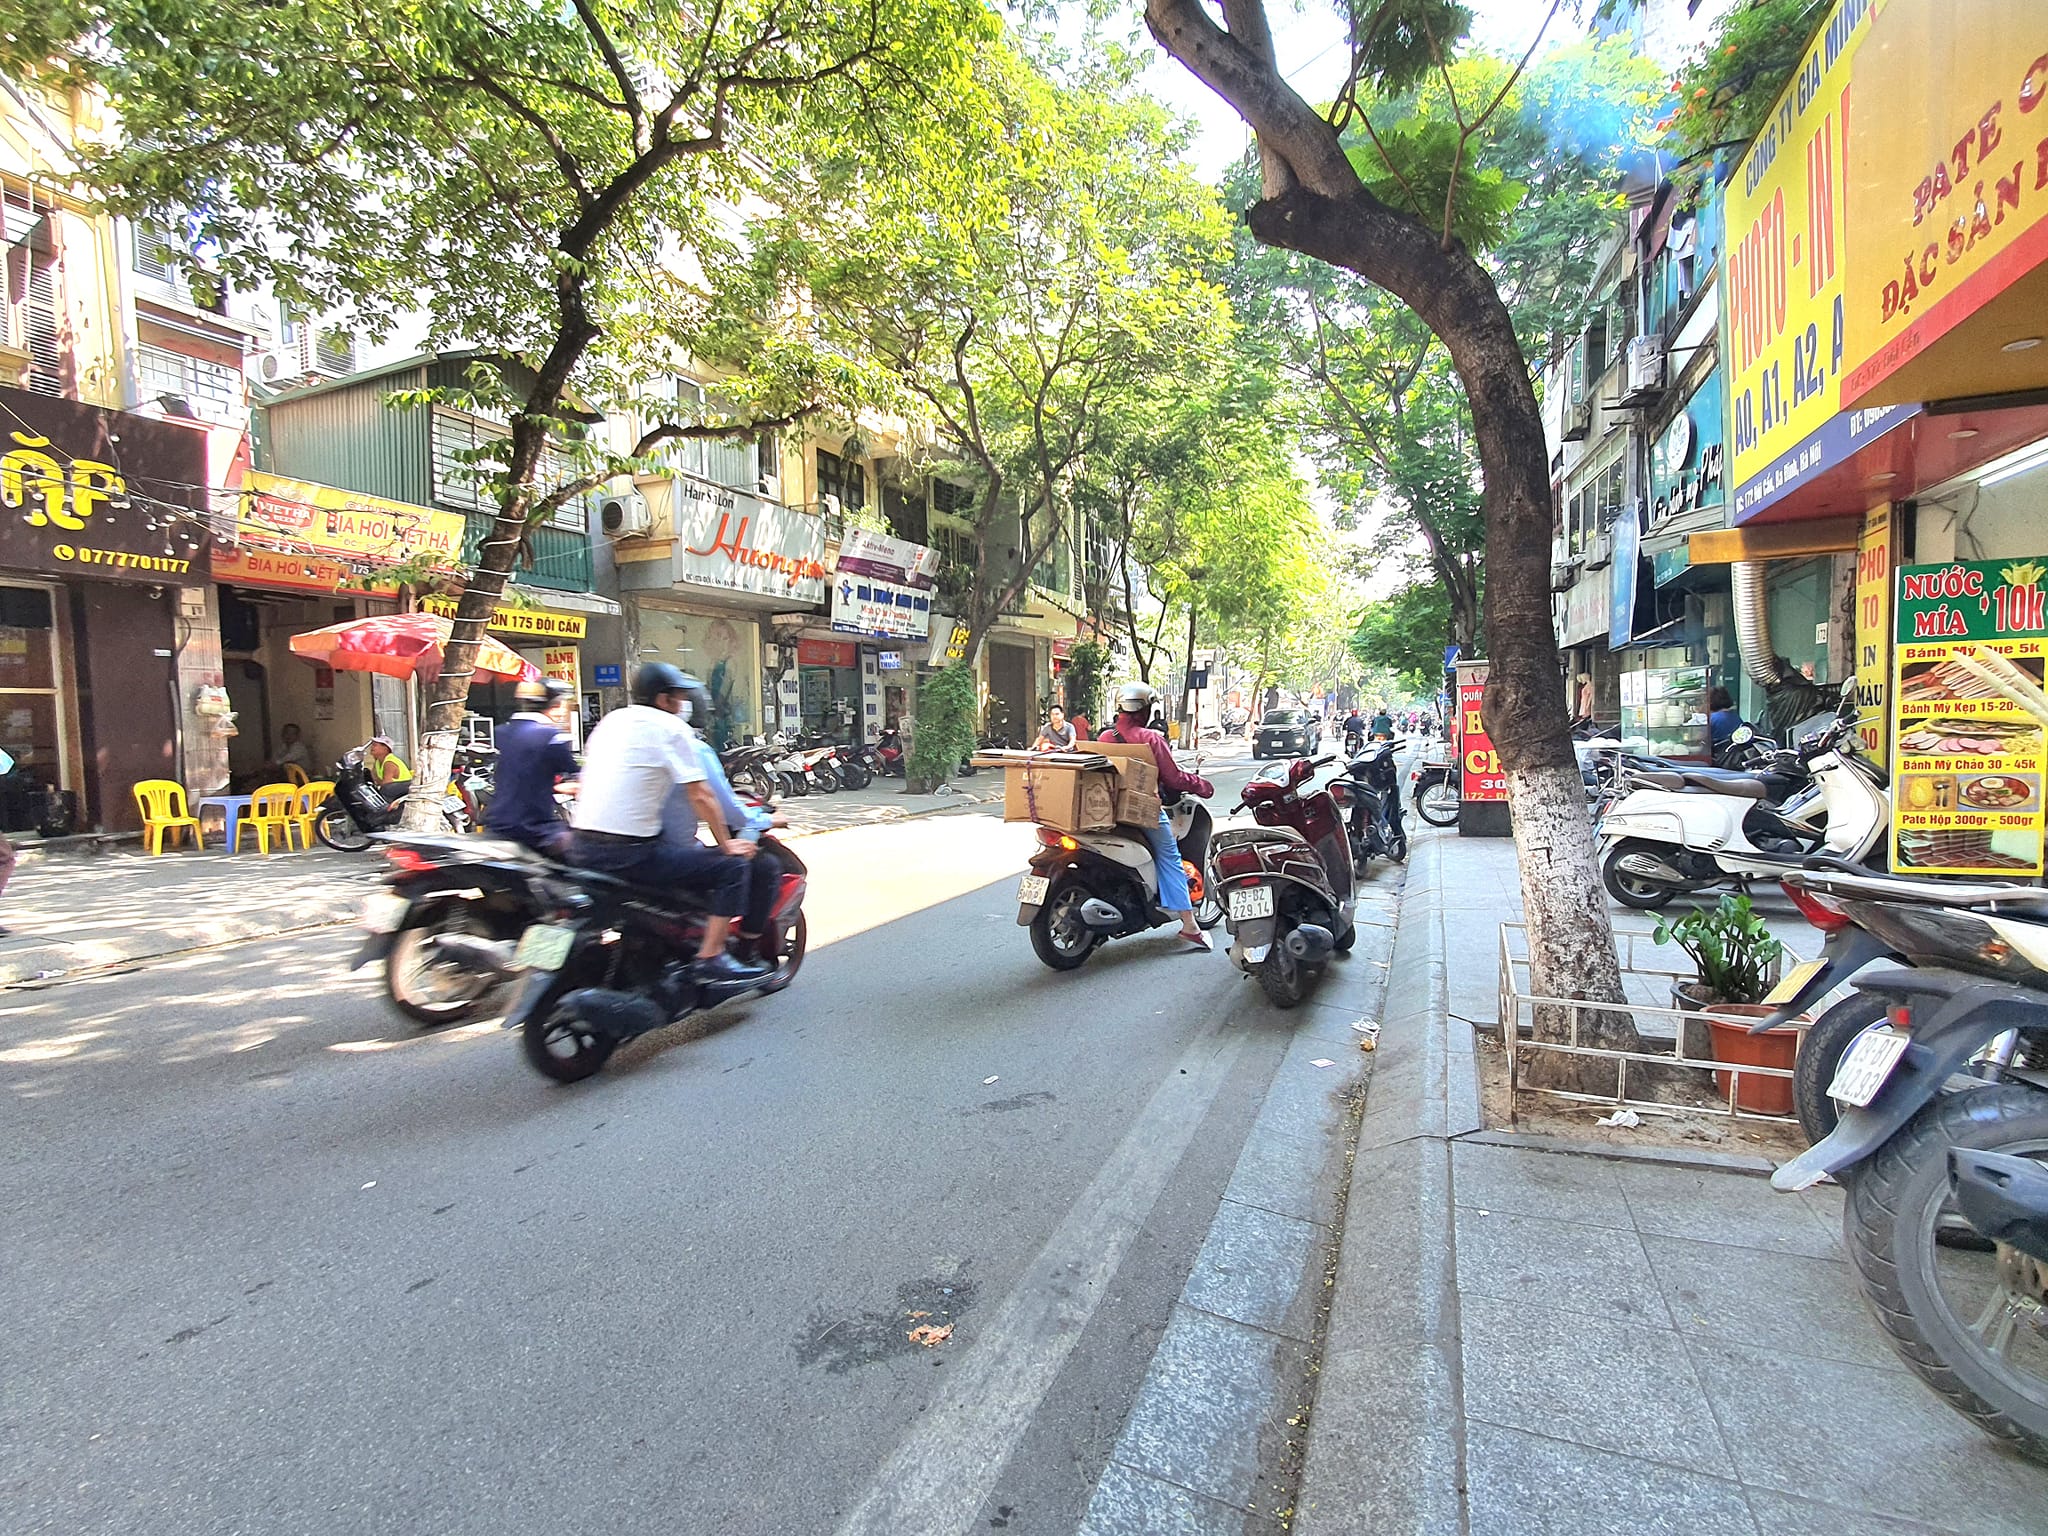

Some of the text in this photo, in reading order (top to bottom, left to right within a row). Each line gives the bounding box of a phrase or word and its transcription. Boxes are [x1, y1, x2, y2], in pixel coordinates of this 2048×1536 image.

[1779, 91, 1793, 144] TY
[1798, 50, 1820, 117] GIA
[1913, 100, 2002, 227] PATE
[1728, 185, 1786, 384] PHOTO
[1806, 112, 1835, 299] IN
[1881, 241, 1939, 324] ĐẶC
[1946, 160, 2024, 266] SẢN
[1761, 359, 1788, 435] A1,
[1793, 321, 1825, 409] A2,
[326, 512, 355, 534] BIA
[359, 519, 389, 539] HƠI
[429, 530, 450, 550] HÀ
[79, 547, 190, 574] 0777701177
[247, 557, 272, 573] BIA
[276, 561, 302, 576] HƠI
[353, 565, 370, 575] 175
[1857, 544, 1886, 586] PHO
[1903, 564, 1984, 601] NƯỚC
[1862, 594, 1879, 629] TO
[1913, 603, 1969, 638] MÍA
[1992, 582, 2046, 633] 10k
[512, 615, 533, 629] 175
[536, 616, 555, 634] ĐỘI
[558, 617, 580, 634] CẤN
[1863, 644, 1877, 668] IN
[1906, 648, 1947, 659] Bánh
[2019, 643, 2040, 653] 5k
[1855, 679, 1883, 707] MÀU
[1902, 703, 1931, 714] Bánh
[1954, 702, 1977, 715] Kẹp
[1903, 760, 1931, 770] Bánh
[1988, 759, 2002, 770] 30
[2014, 759, 2036, 770] 45k
[1902, 815, 1927, 825] Pate
[1929, 814, 1951, 827] Hộp
[1954, 815, 1988, 827] 300gr
[1999, 815, 2034, 828] 500gr
[1233, 902, 1270, 919] 229.14
